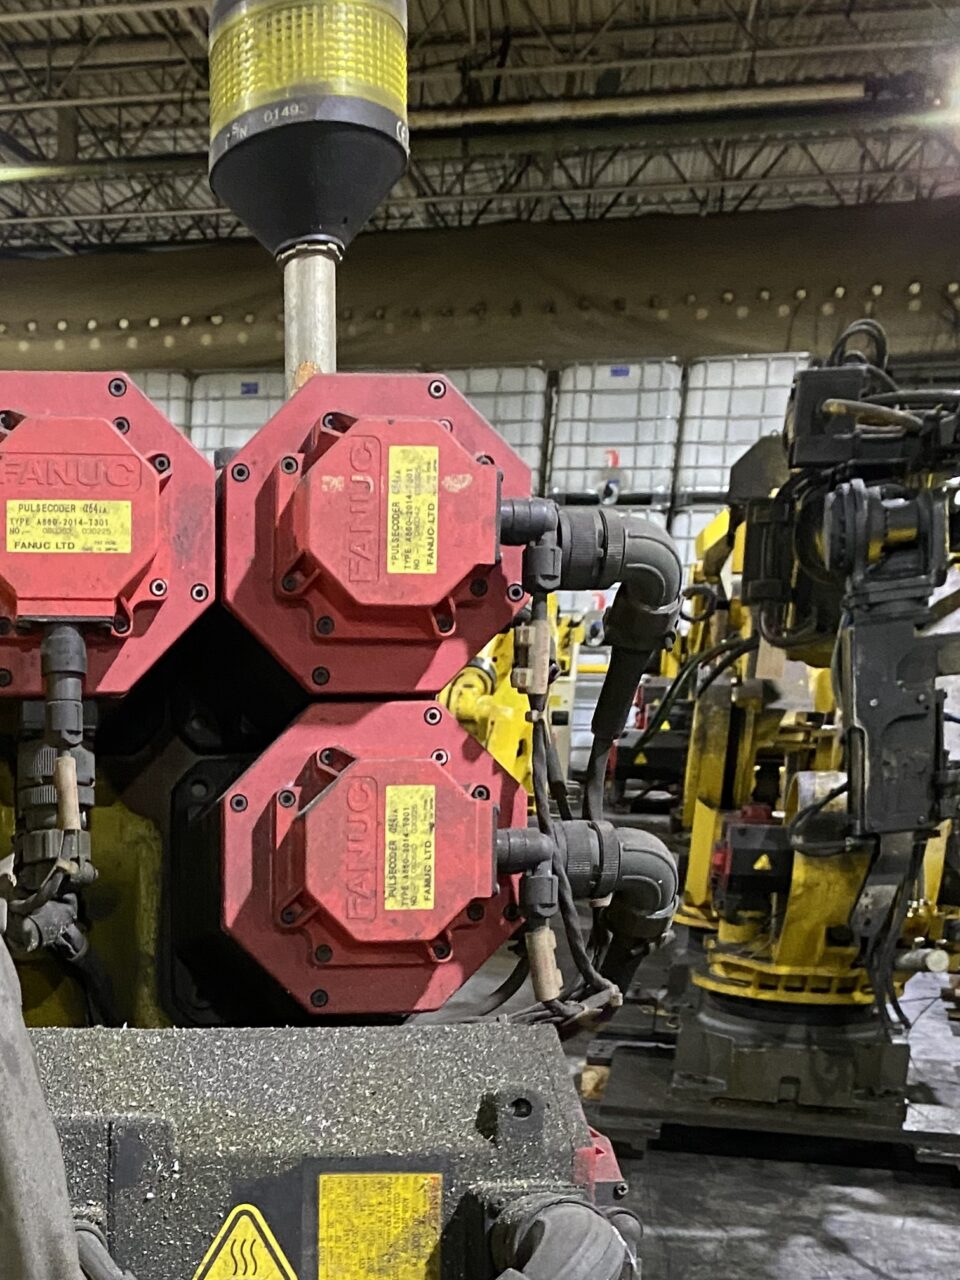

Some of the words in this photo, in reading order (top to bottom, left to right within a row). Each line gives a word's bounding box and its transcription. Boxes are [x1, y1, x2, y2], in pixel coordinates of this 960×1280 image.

[10, 518, 30, 526] TYPE
[18, 503, 76, 513] PULSECODER
[349, 441, 374, 582] FANUC
[14, 541, 51, 550] FANUC
[56, 541, 75, 550] LTD
[391, 501, 401, 561] PULSECODER
[427, 529, 435, 566] FANUC
[404, 548, 412, 570] TYPE
[346, 782, 370, 921] FANUC
[389, 840, 397, 898] PULSECODER
[401, 885, 409, 907] TYPE
[424, 866, 432, 901] FANUC
